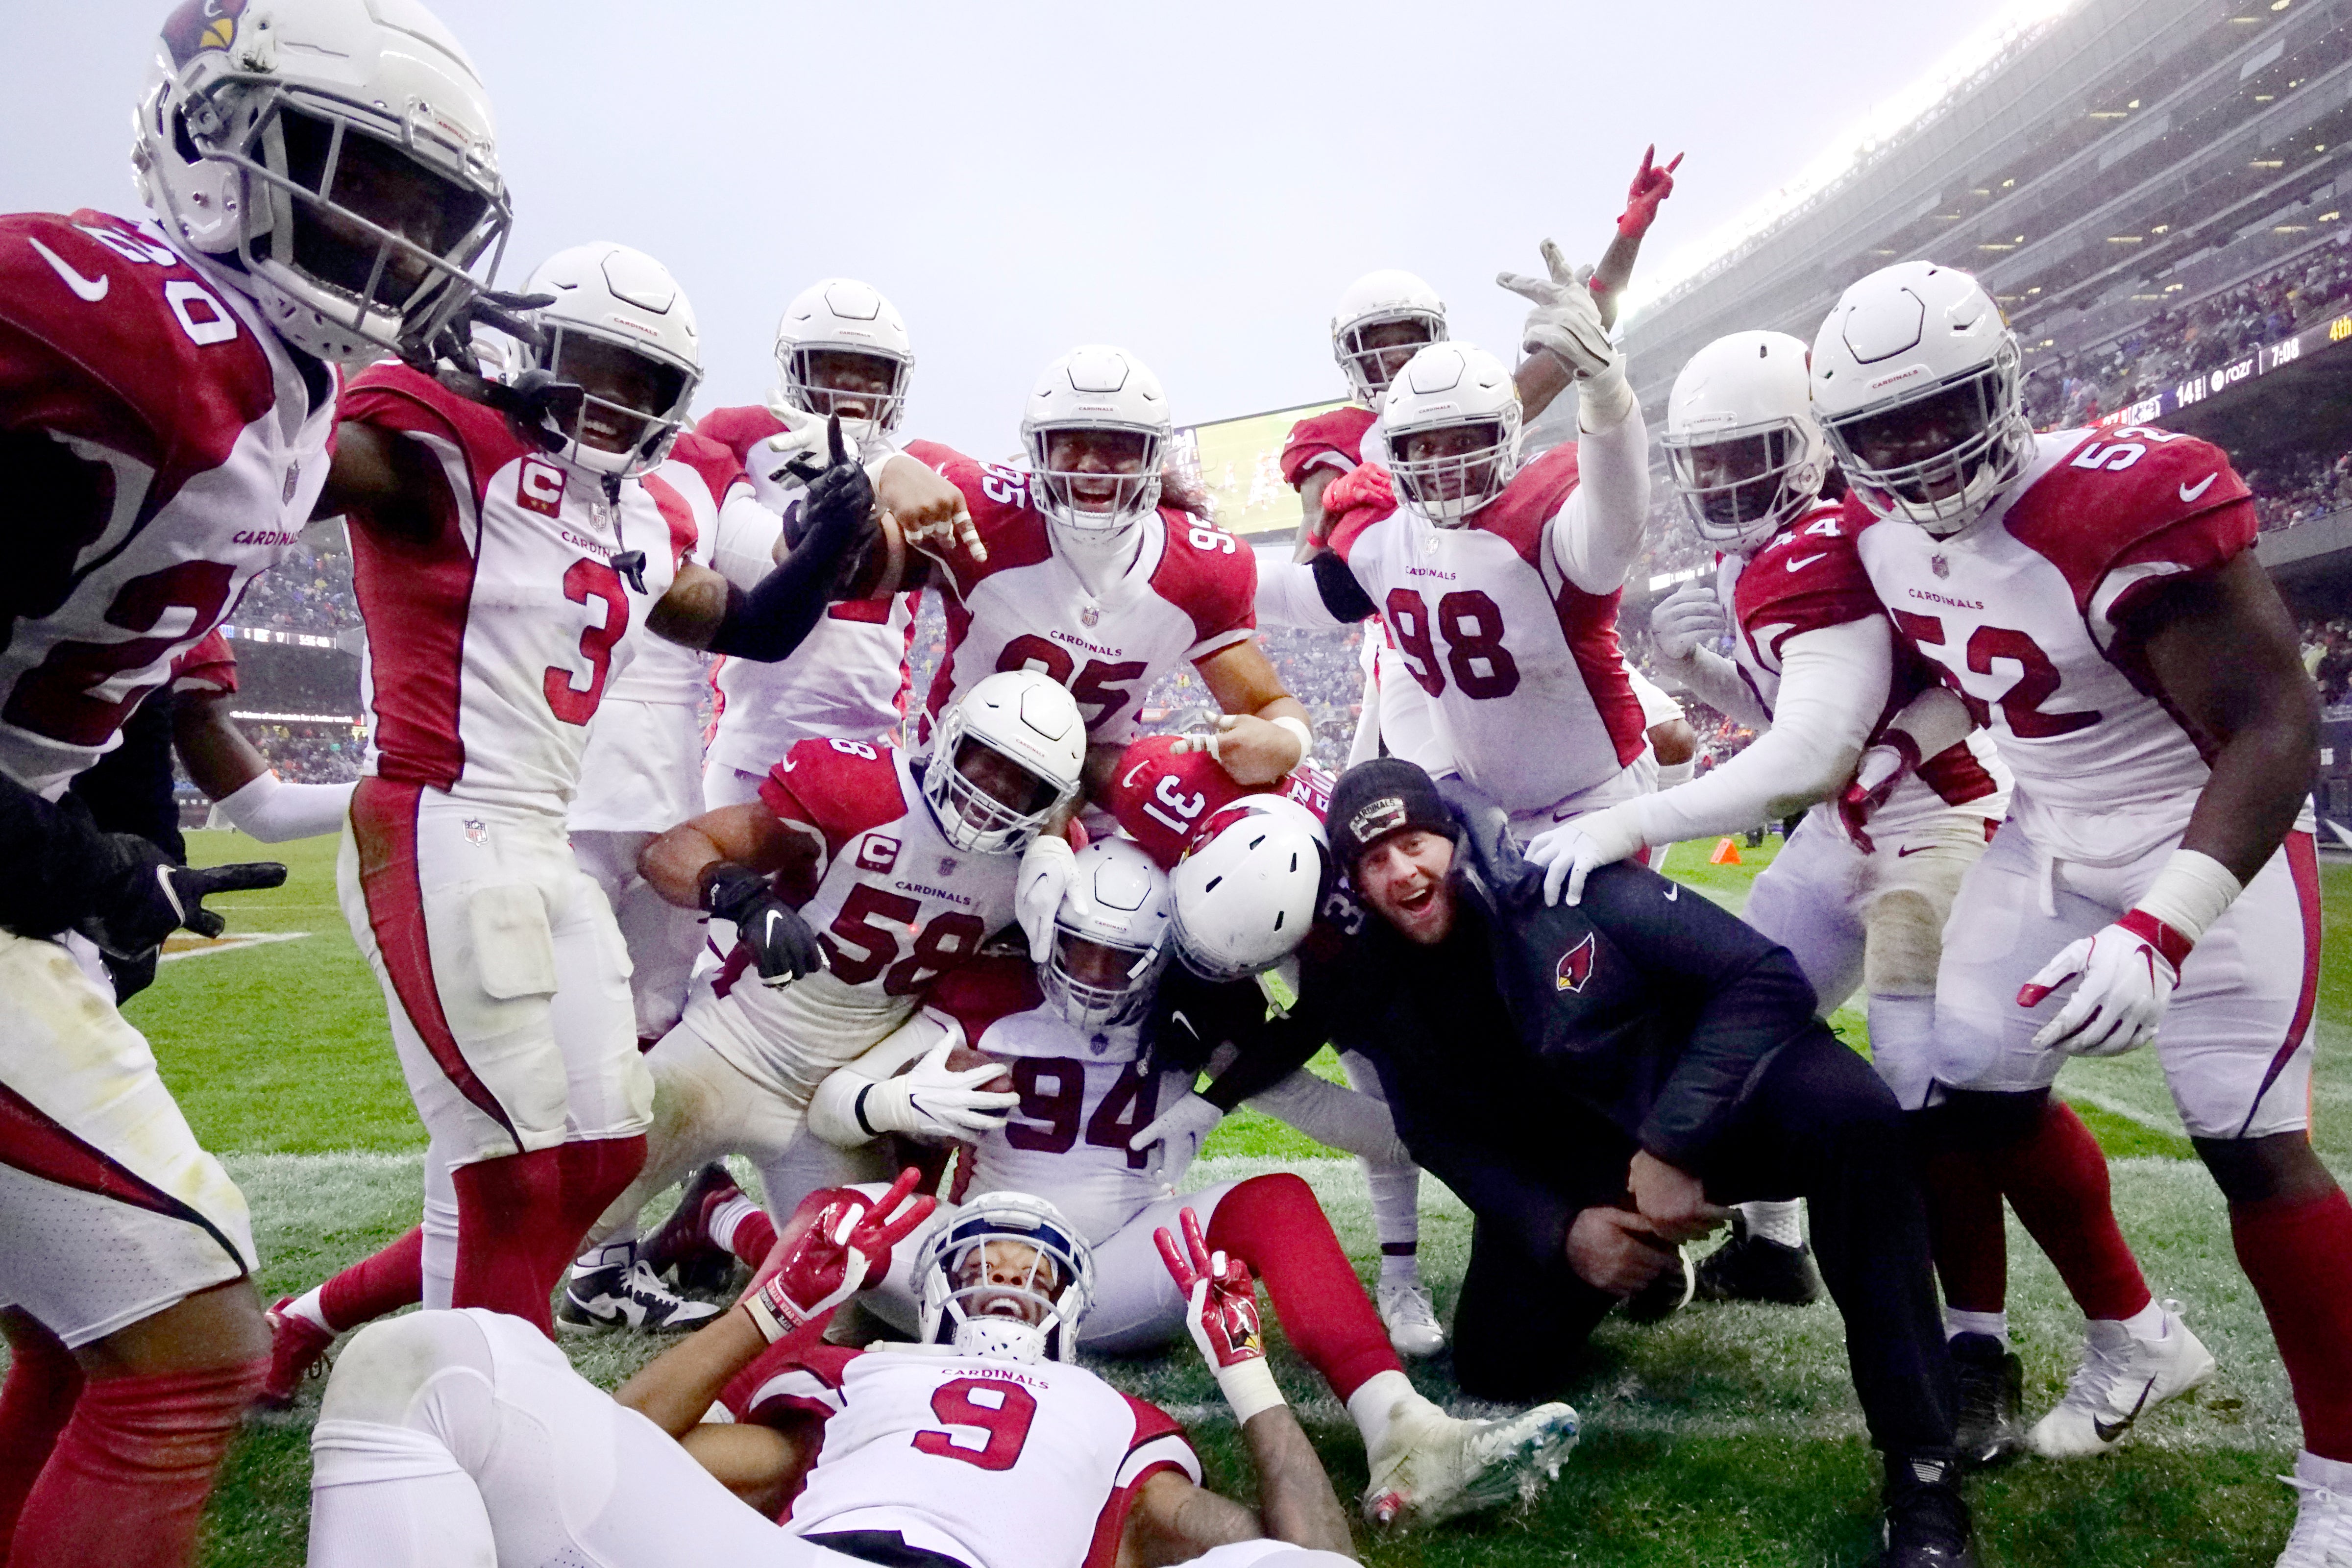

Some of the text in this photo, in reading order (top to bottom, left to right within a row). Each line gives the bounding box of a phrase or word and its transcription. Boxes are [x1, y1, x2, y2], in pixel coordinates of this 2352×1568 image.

[614, 318, 658, 337] CARDINALS
[2272, 338, 2299, 367] 7:08
[1872, 369, 1918, 389] CARDINALS
[1419, 405, 1450, 414] CARDINALS
[2070, 426, 2187, 471] 52
[561, 531, 617, 559] CARDIN
[1909, 588, 1984, 610] CARDINALS
[543, 557, 630, 727] 3
[1050, 630, 1123, 657] CARDINALS
[1386, 588, 1520, 700] 98
[1890, 607, 2104, 738] 52
[1016, 738, 1045, 758] CARDINALS
[1142, 774, 1206, 834] 31
[895, 880, 972, 906] CARDINALS
[817, 882, 985, 996] 58
[1005, 1056, 1160, 1169] 94
[941, 1369, 1050, 1390] CARDINALS
[910, 1376, 1038, 1470] 9
